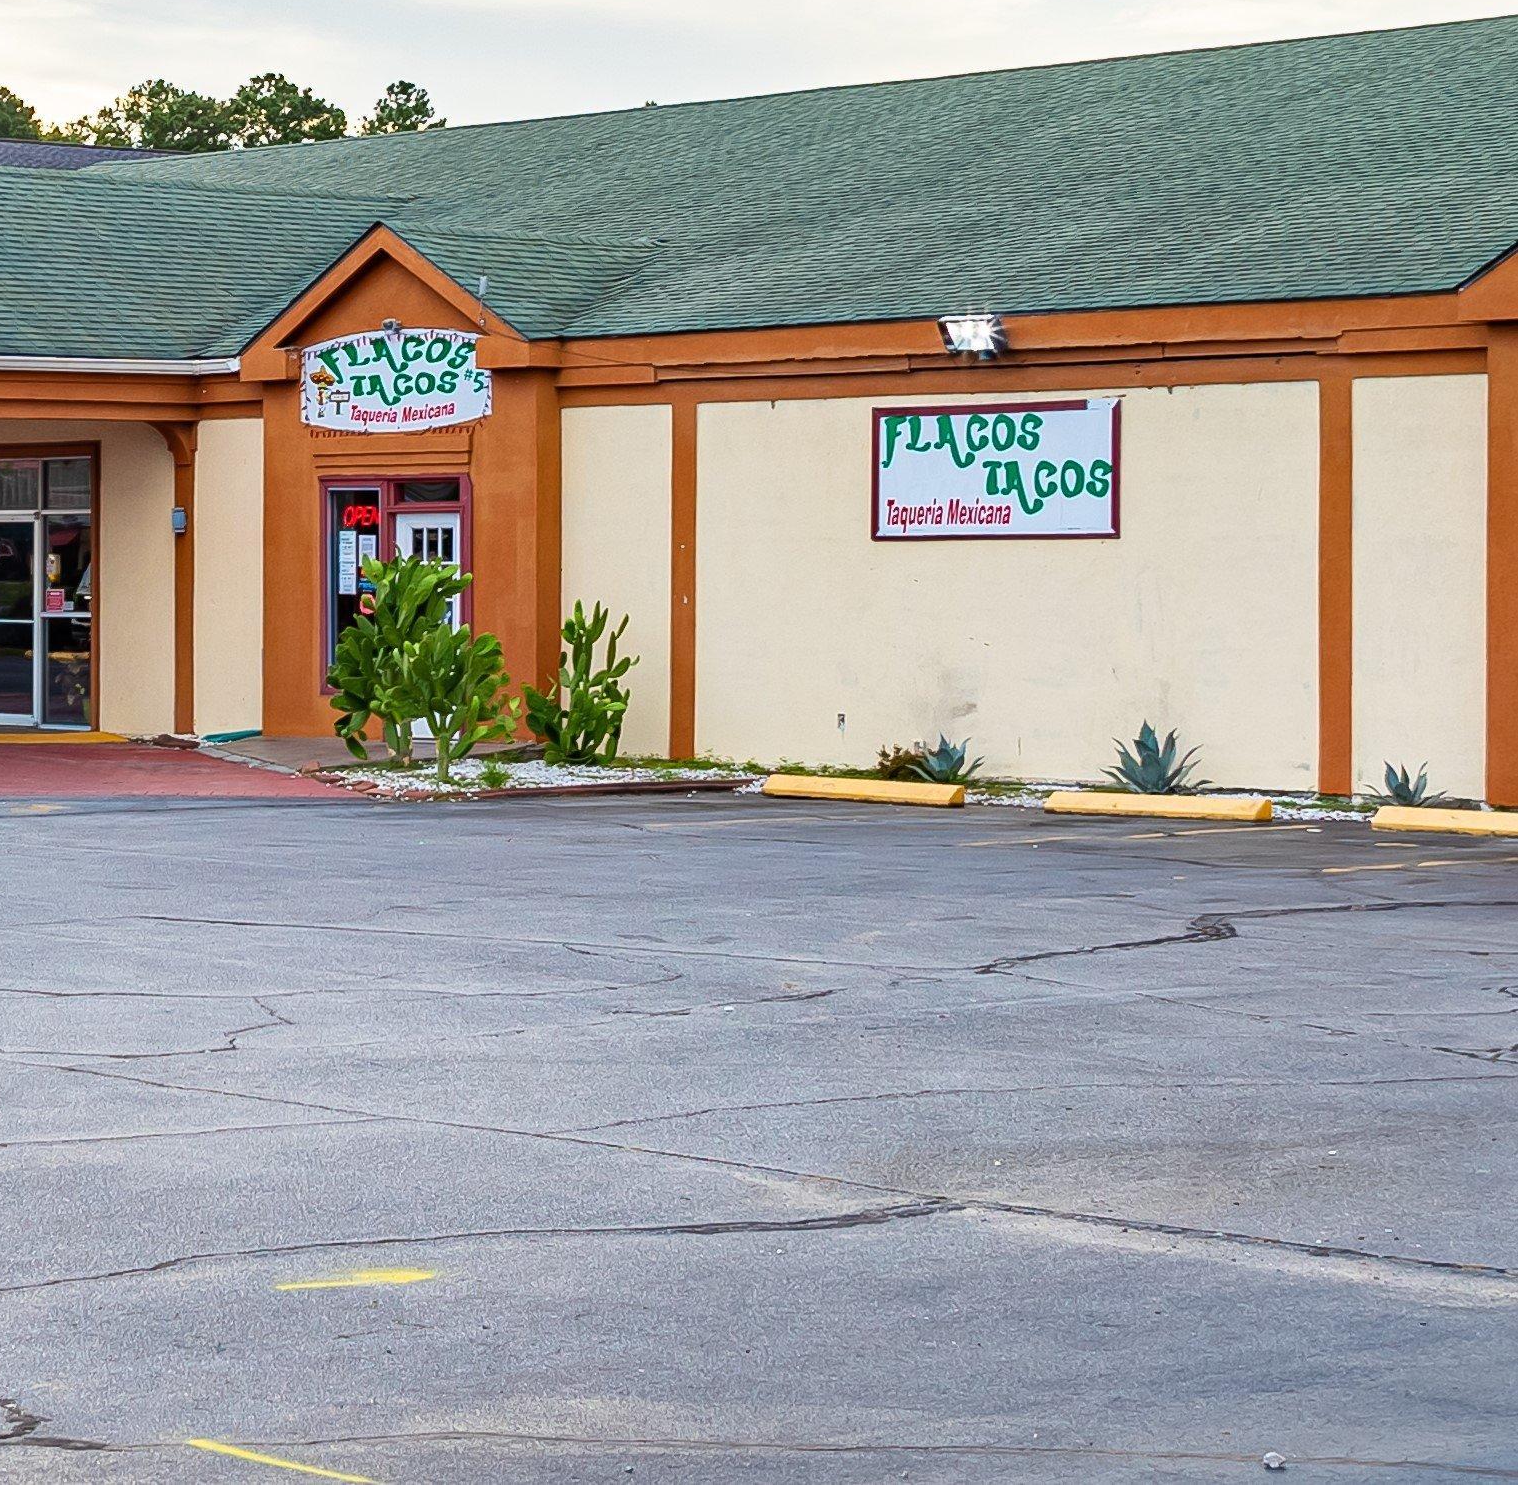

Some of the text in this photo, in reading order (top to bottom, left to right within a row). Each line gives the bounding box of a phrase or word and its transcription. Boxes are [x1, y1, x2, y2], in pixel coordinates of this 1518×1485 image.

[317, 336, 476, 385] FLACOS
[350, 368, 486, 407] TACOS #5
[401, 402, 455, 423] Mexicana
[882, 413, 1043, 468] FLACOS
[982, 459, 1113, 515] TACOS
[946, 497, 1011, 526] Mexicana
